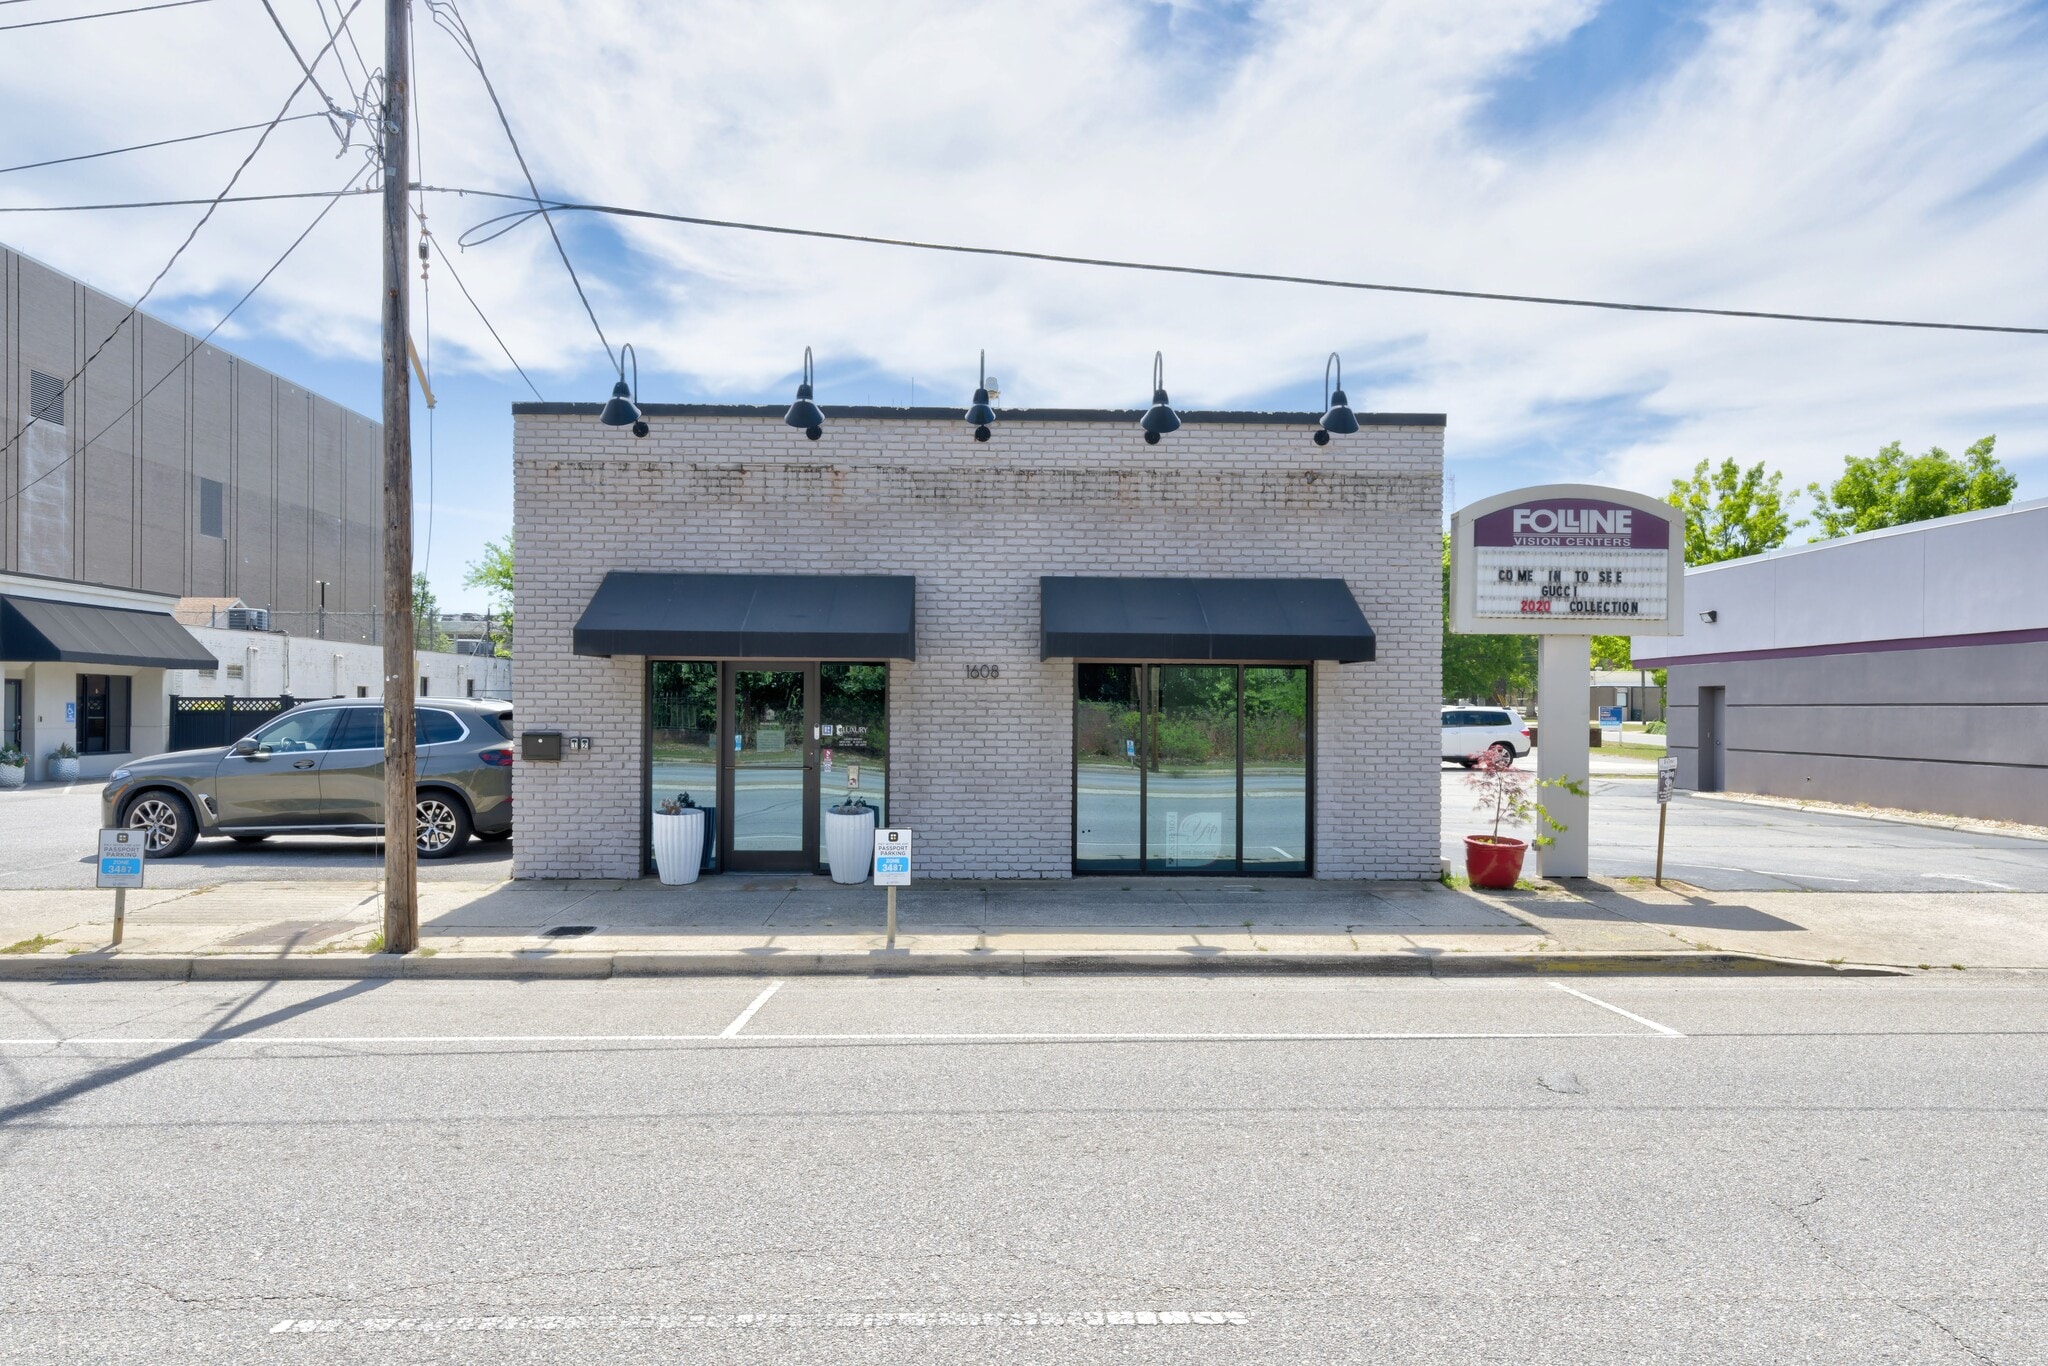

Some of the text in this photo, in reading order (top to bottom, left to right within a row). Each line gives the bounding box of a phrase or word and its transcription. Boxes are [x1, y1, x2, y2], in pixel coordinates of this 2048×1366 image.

[1513, 508, 1632, 534] FOLLINE
[1514, 537, 1631, 546] VISION CENTERS
[1498, 570, 1622, 583] COME IN TO SEE
[1541, 586, 1578, 597] GUCCI
[1520, 601, 1638, 613] 2020 COLLECTION
[966, 664, 999, 679] 1608
[882, 864, 903, 872] 3487
